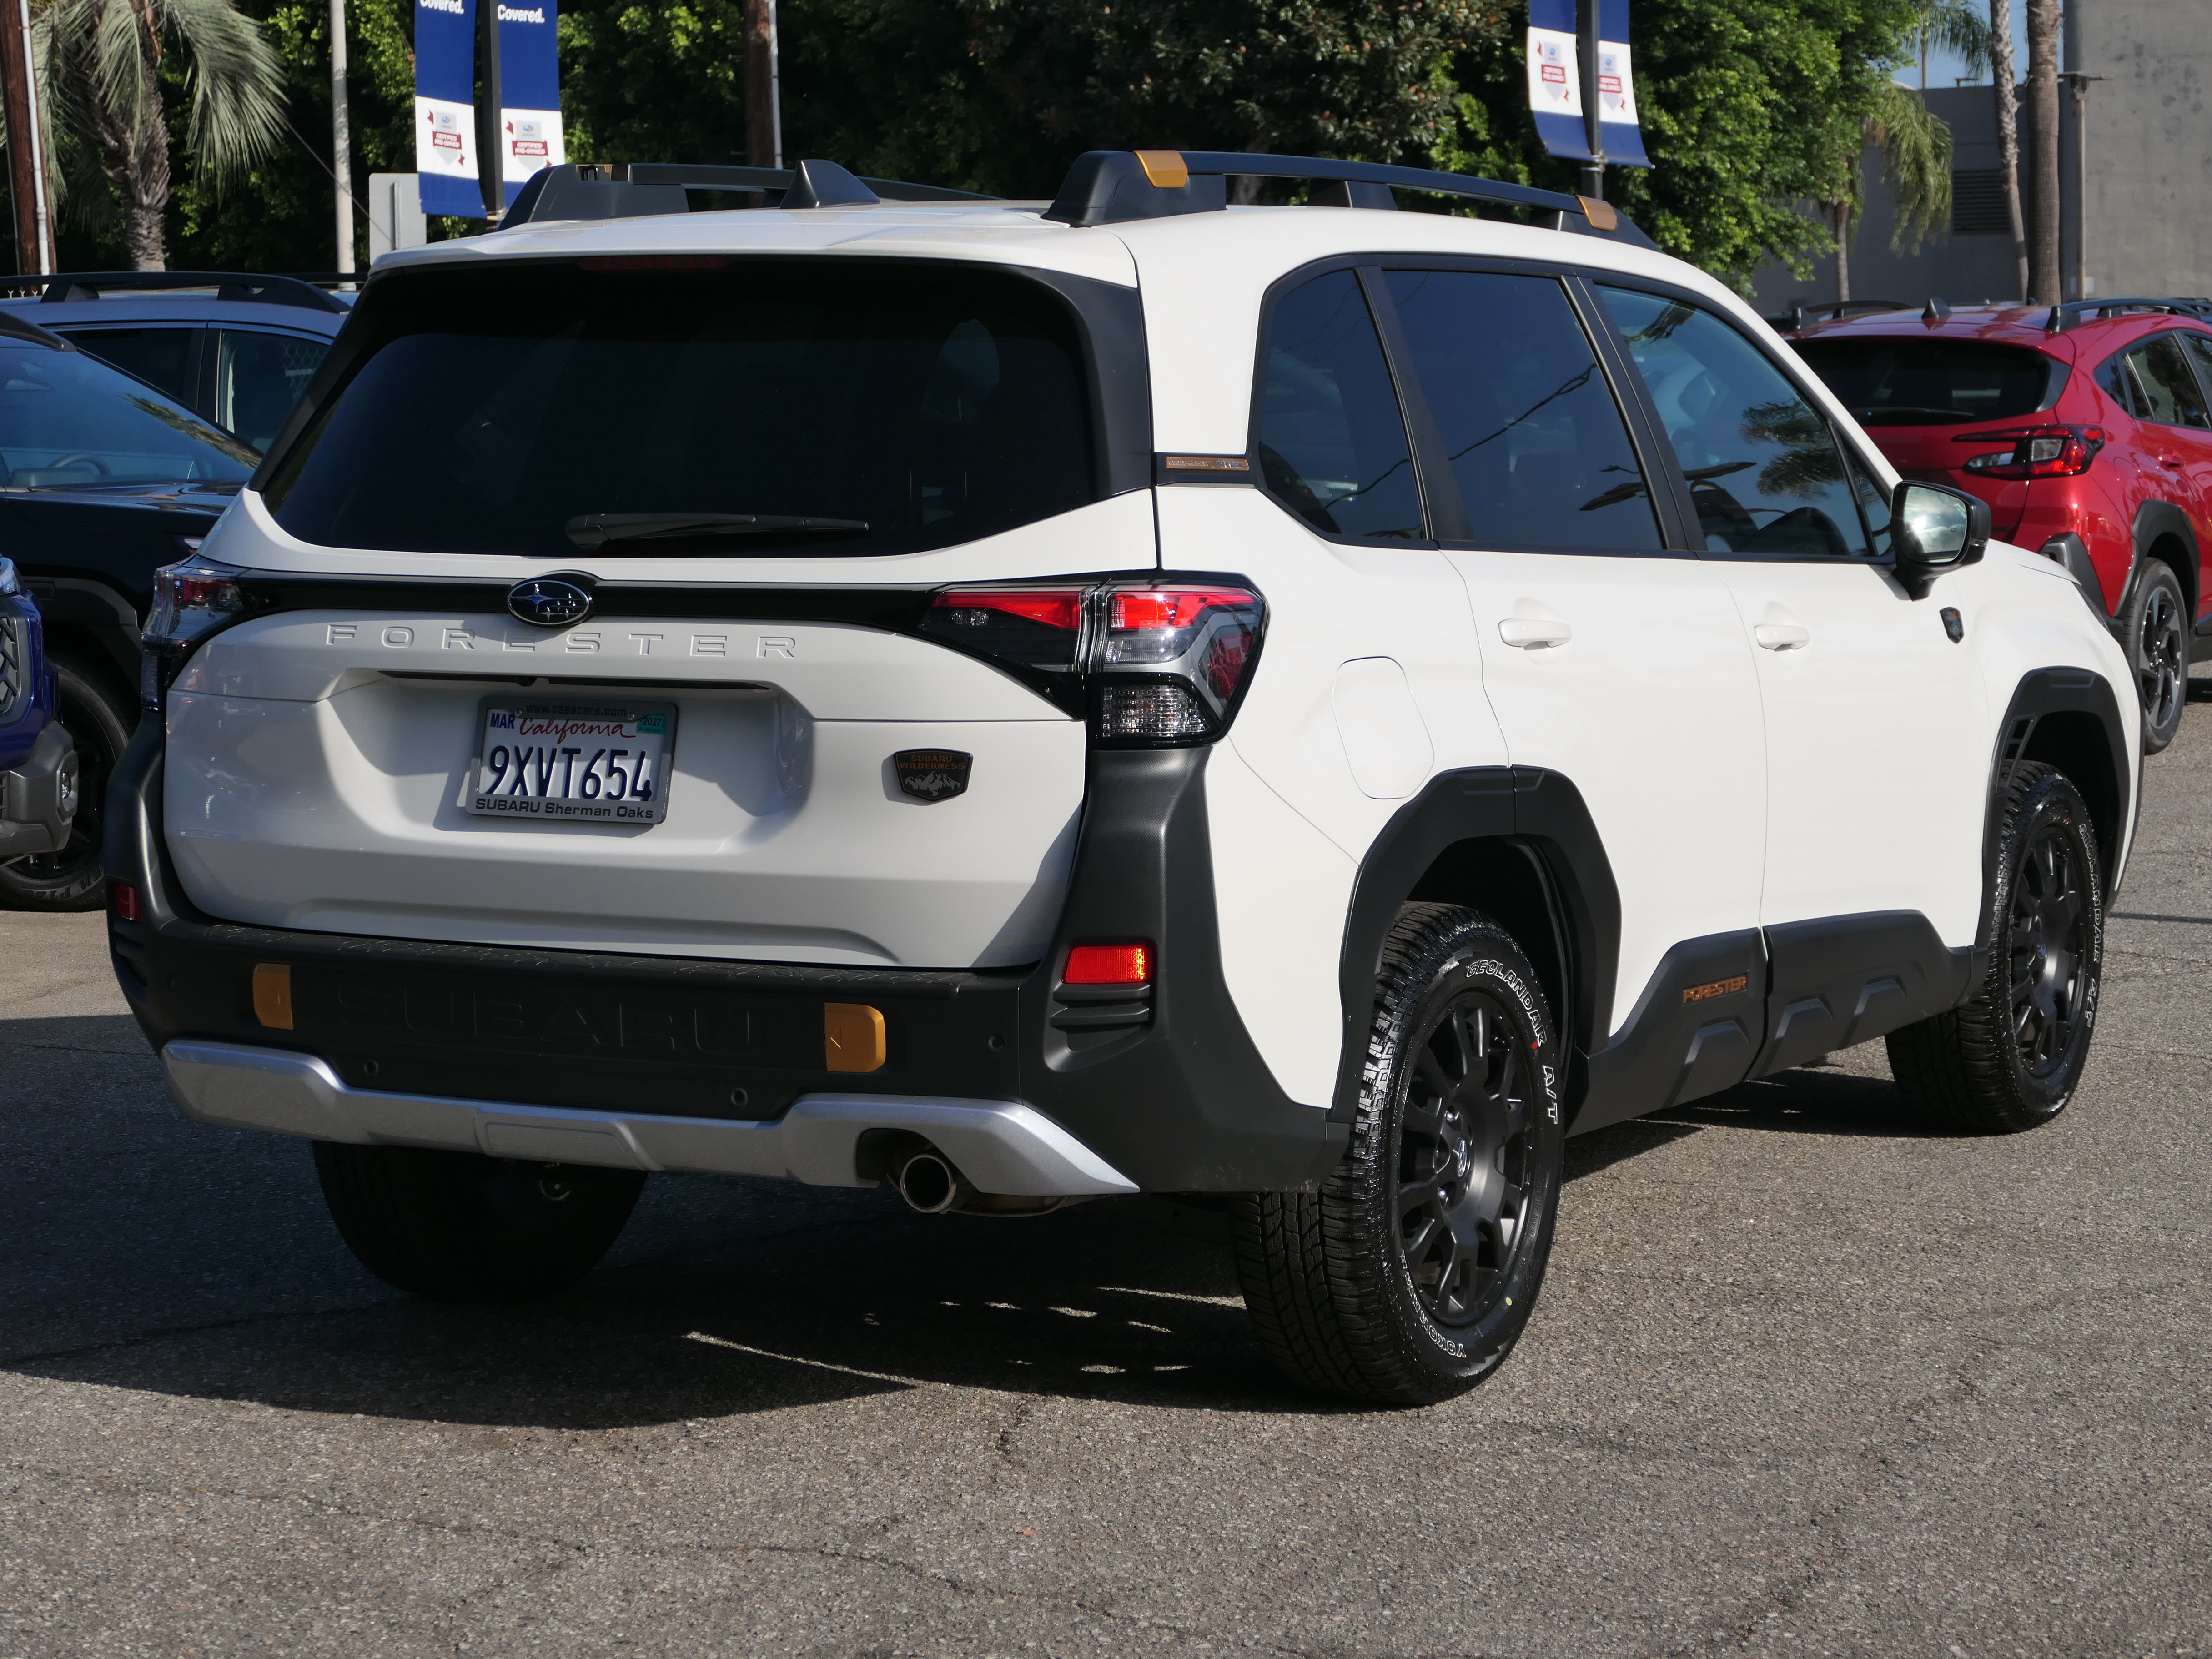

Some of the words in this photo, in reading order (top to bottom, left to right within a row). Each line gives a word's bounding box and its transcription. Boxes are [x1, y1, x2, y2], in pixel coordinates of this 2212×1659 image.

[498, 5, 545, 23] Covered.
[436, 132, 458, 142] CERTIFIED
[326, 624, 796, 659] FORESTER
[490, 713, 515, 729] MAR
[526, 704, 627, 718] www.casacars.com
[519, 718, 636, 744] California
[643, 717, 662, 727] 2027
[486, 745, 652, 801] 9XVT654
[476, 798, 541, 813] SUBARU
[545, 804, 611, 817] Sherman
[616, 805, 654, 819] Oaks
[1683, 976, 1747, 1004] FORESTER
[1465, 959, 1547, 1048] GEOLANDAR
[1542, 1064, 1558, 1125] A/T
